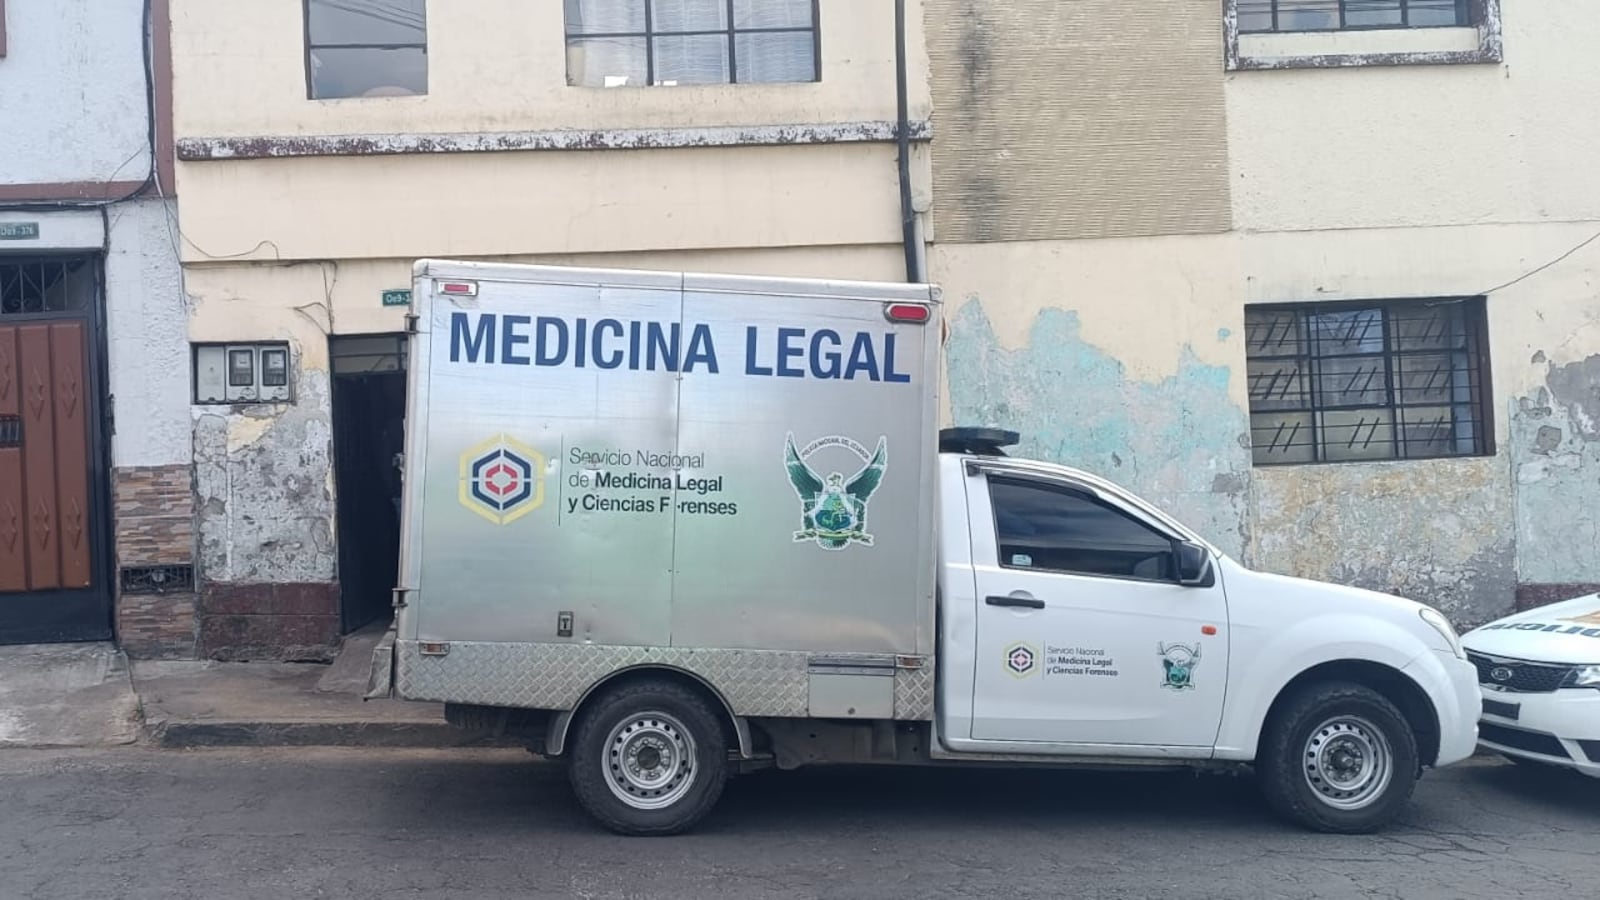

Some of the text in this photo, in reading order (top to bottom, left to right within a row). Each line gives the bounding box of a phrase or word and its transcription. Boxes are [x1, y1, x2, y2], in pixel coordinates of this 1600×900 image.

[449, 311, 911, 384] MEDICINA LEGAL
[569, 447, 705, 469] Servicio Nacional
[568, 471, 722, 495] de Medicina Legal
[567, 494, 737, 516] y Ciencias Frenses
[1047, 645, 1074, 655] Servicio
[1047, 666, 1119, 677] y Ciencias Forenses
[1058, 656, 1091, 666] Medicina
[1092, 658, 1113, 668] Legal
